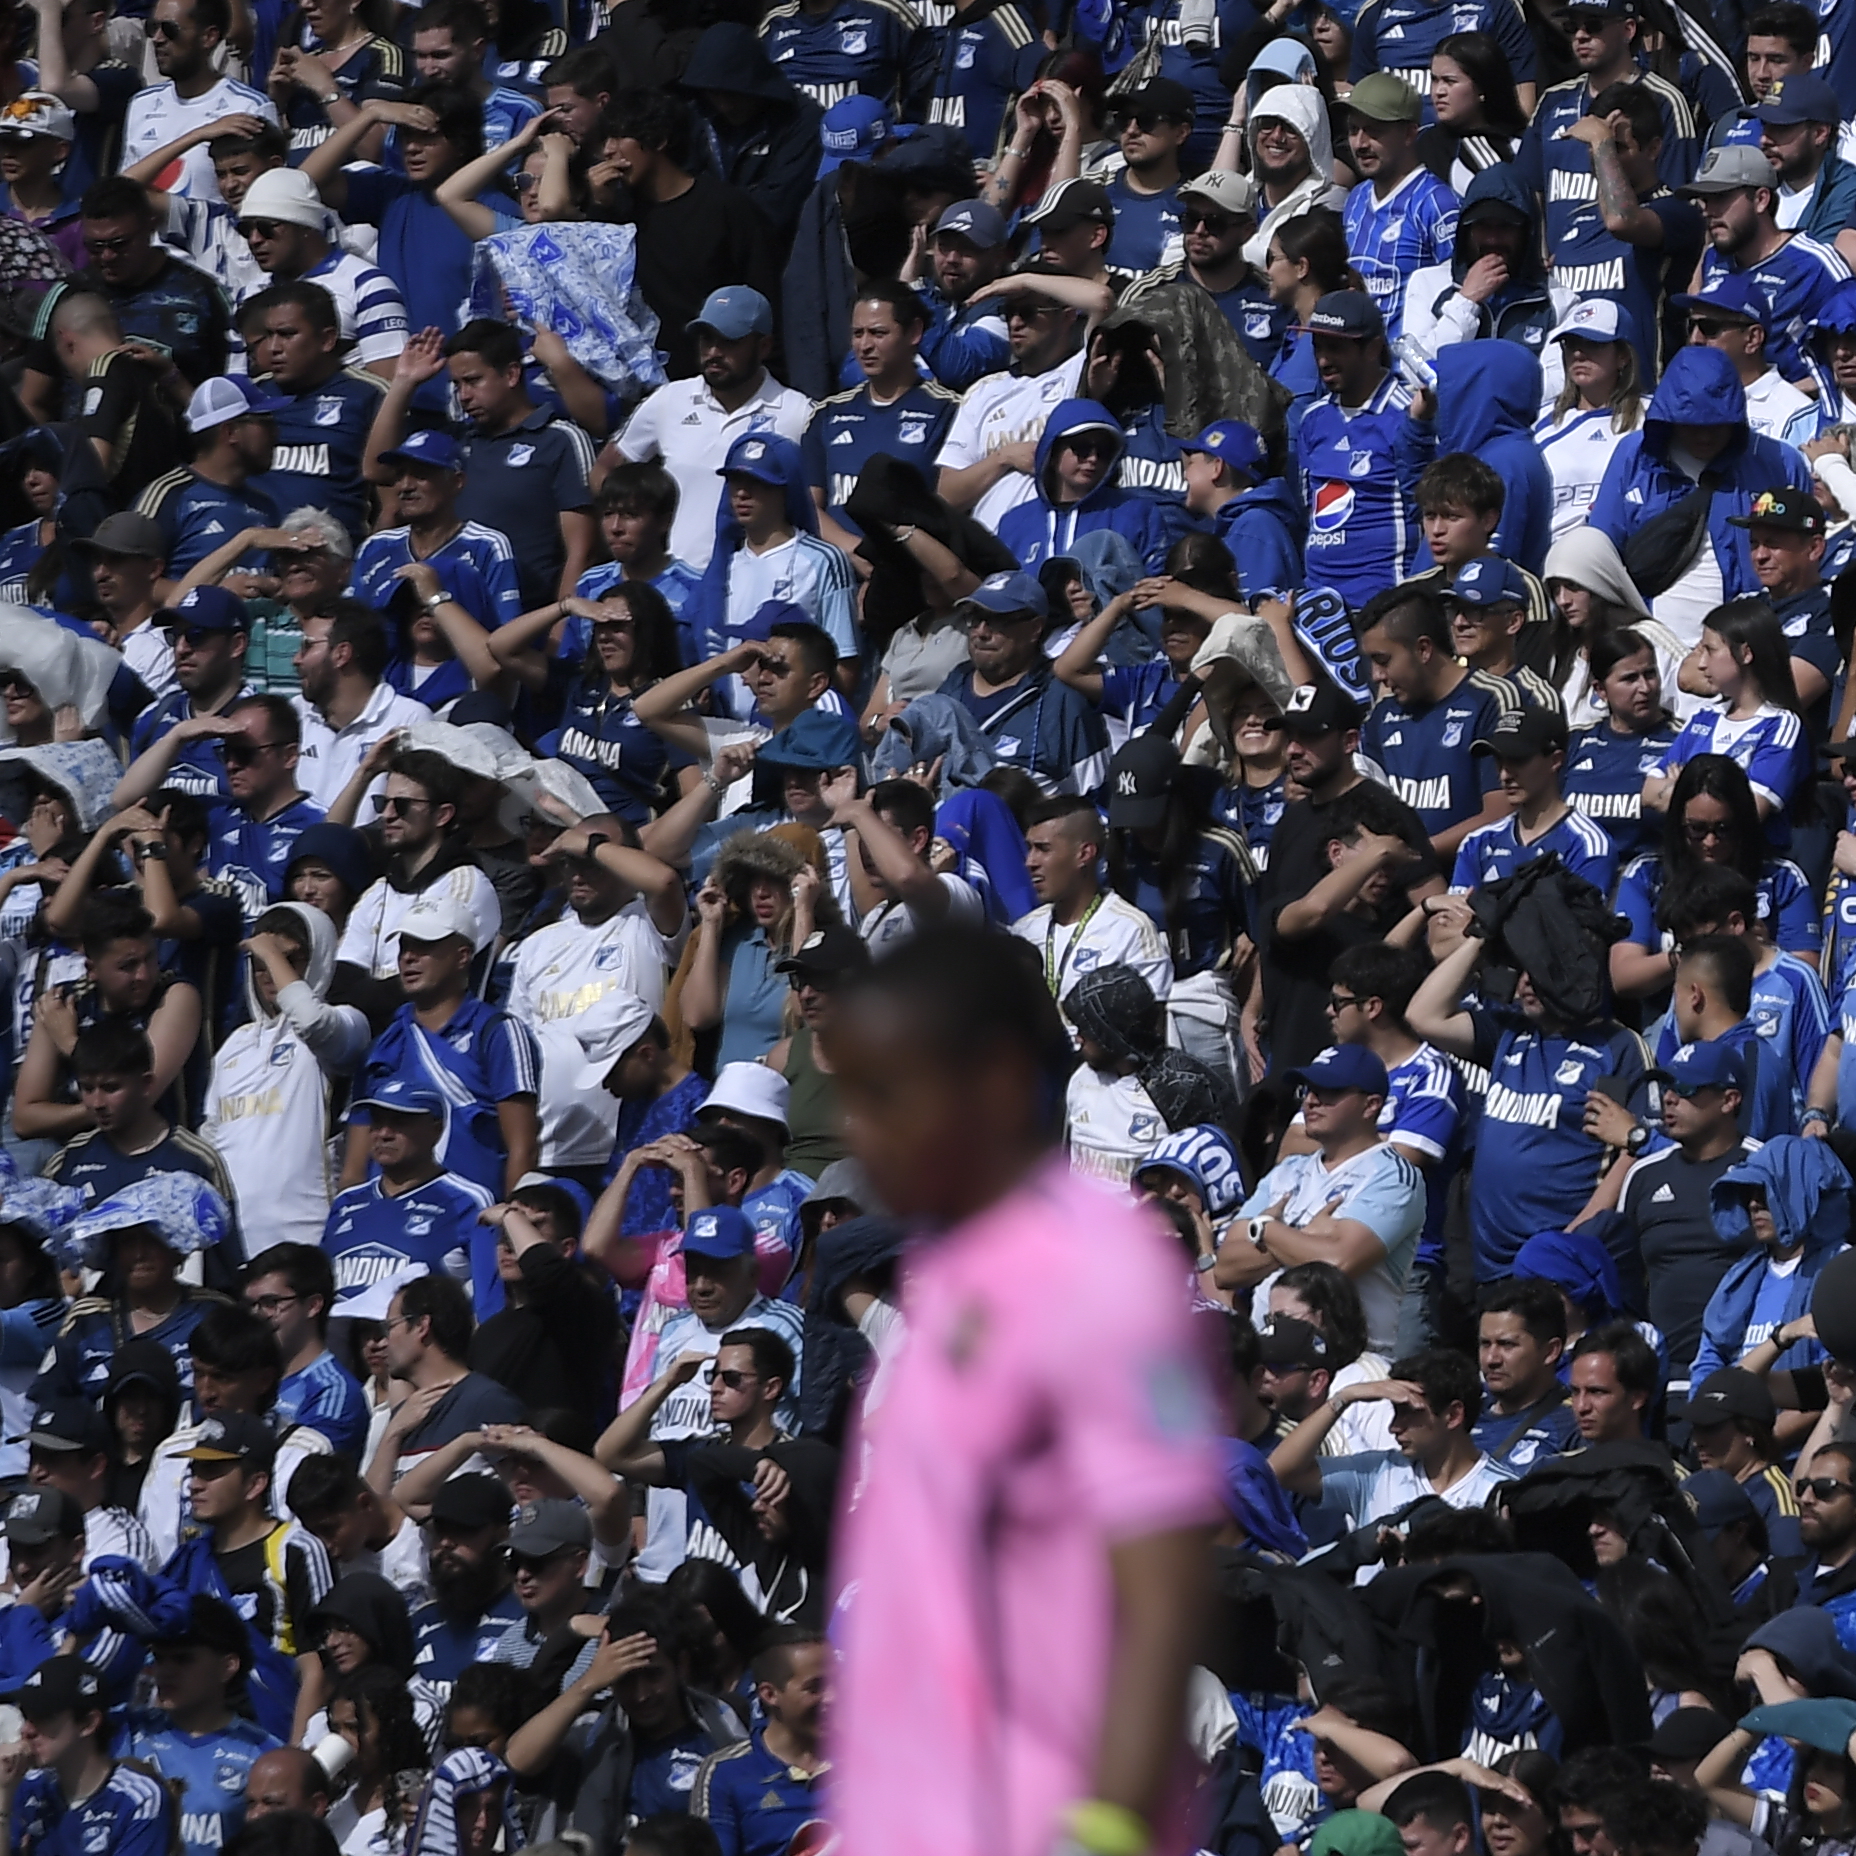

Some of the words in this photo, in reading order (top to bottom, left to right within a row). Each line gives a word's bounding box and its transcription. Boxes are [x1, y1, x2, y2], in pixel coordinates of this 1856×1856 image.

[273, 442, 330, 477] DINA
[1309, 529, 1347, 550] pepsi
[1114, 771, 1137, 796] NY
[1485, 1082, 1561, 1128] ANDINA
